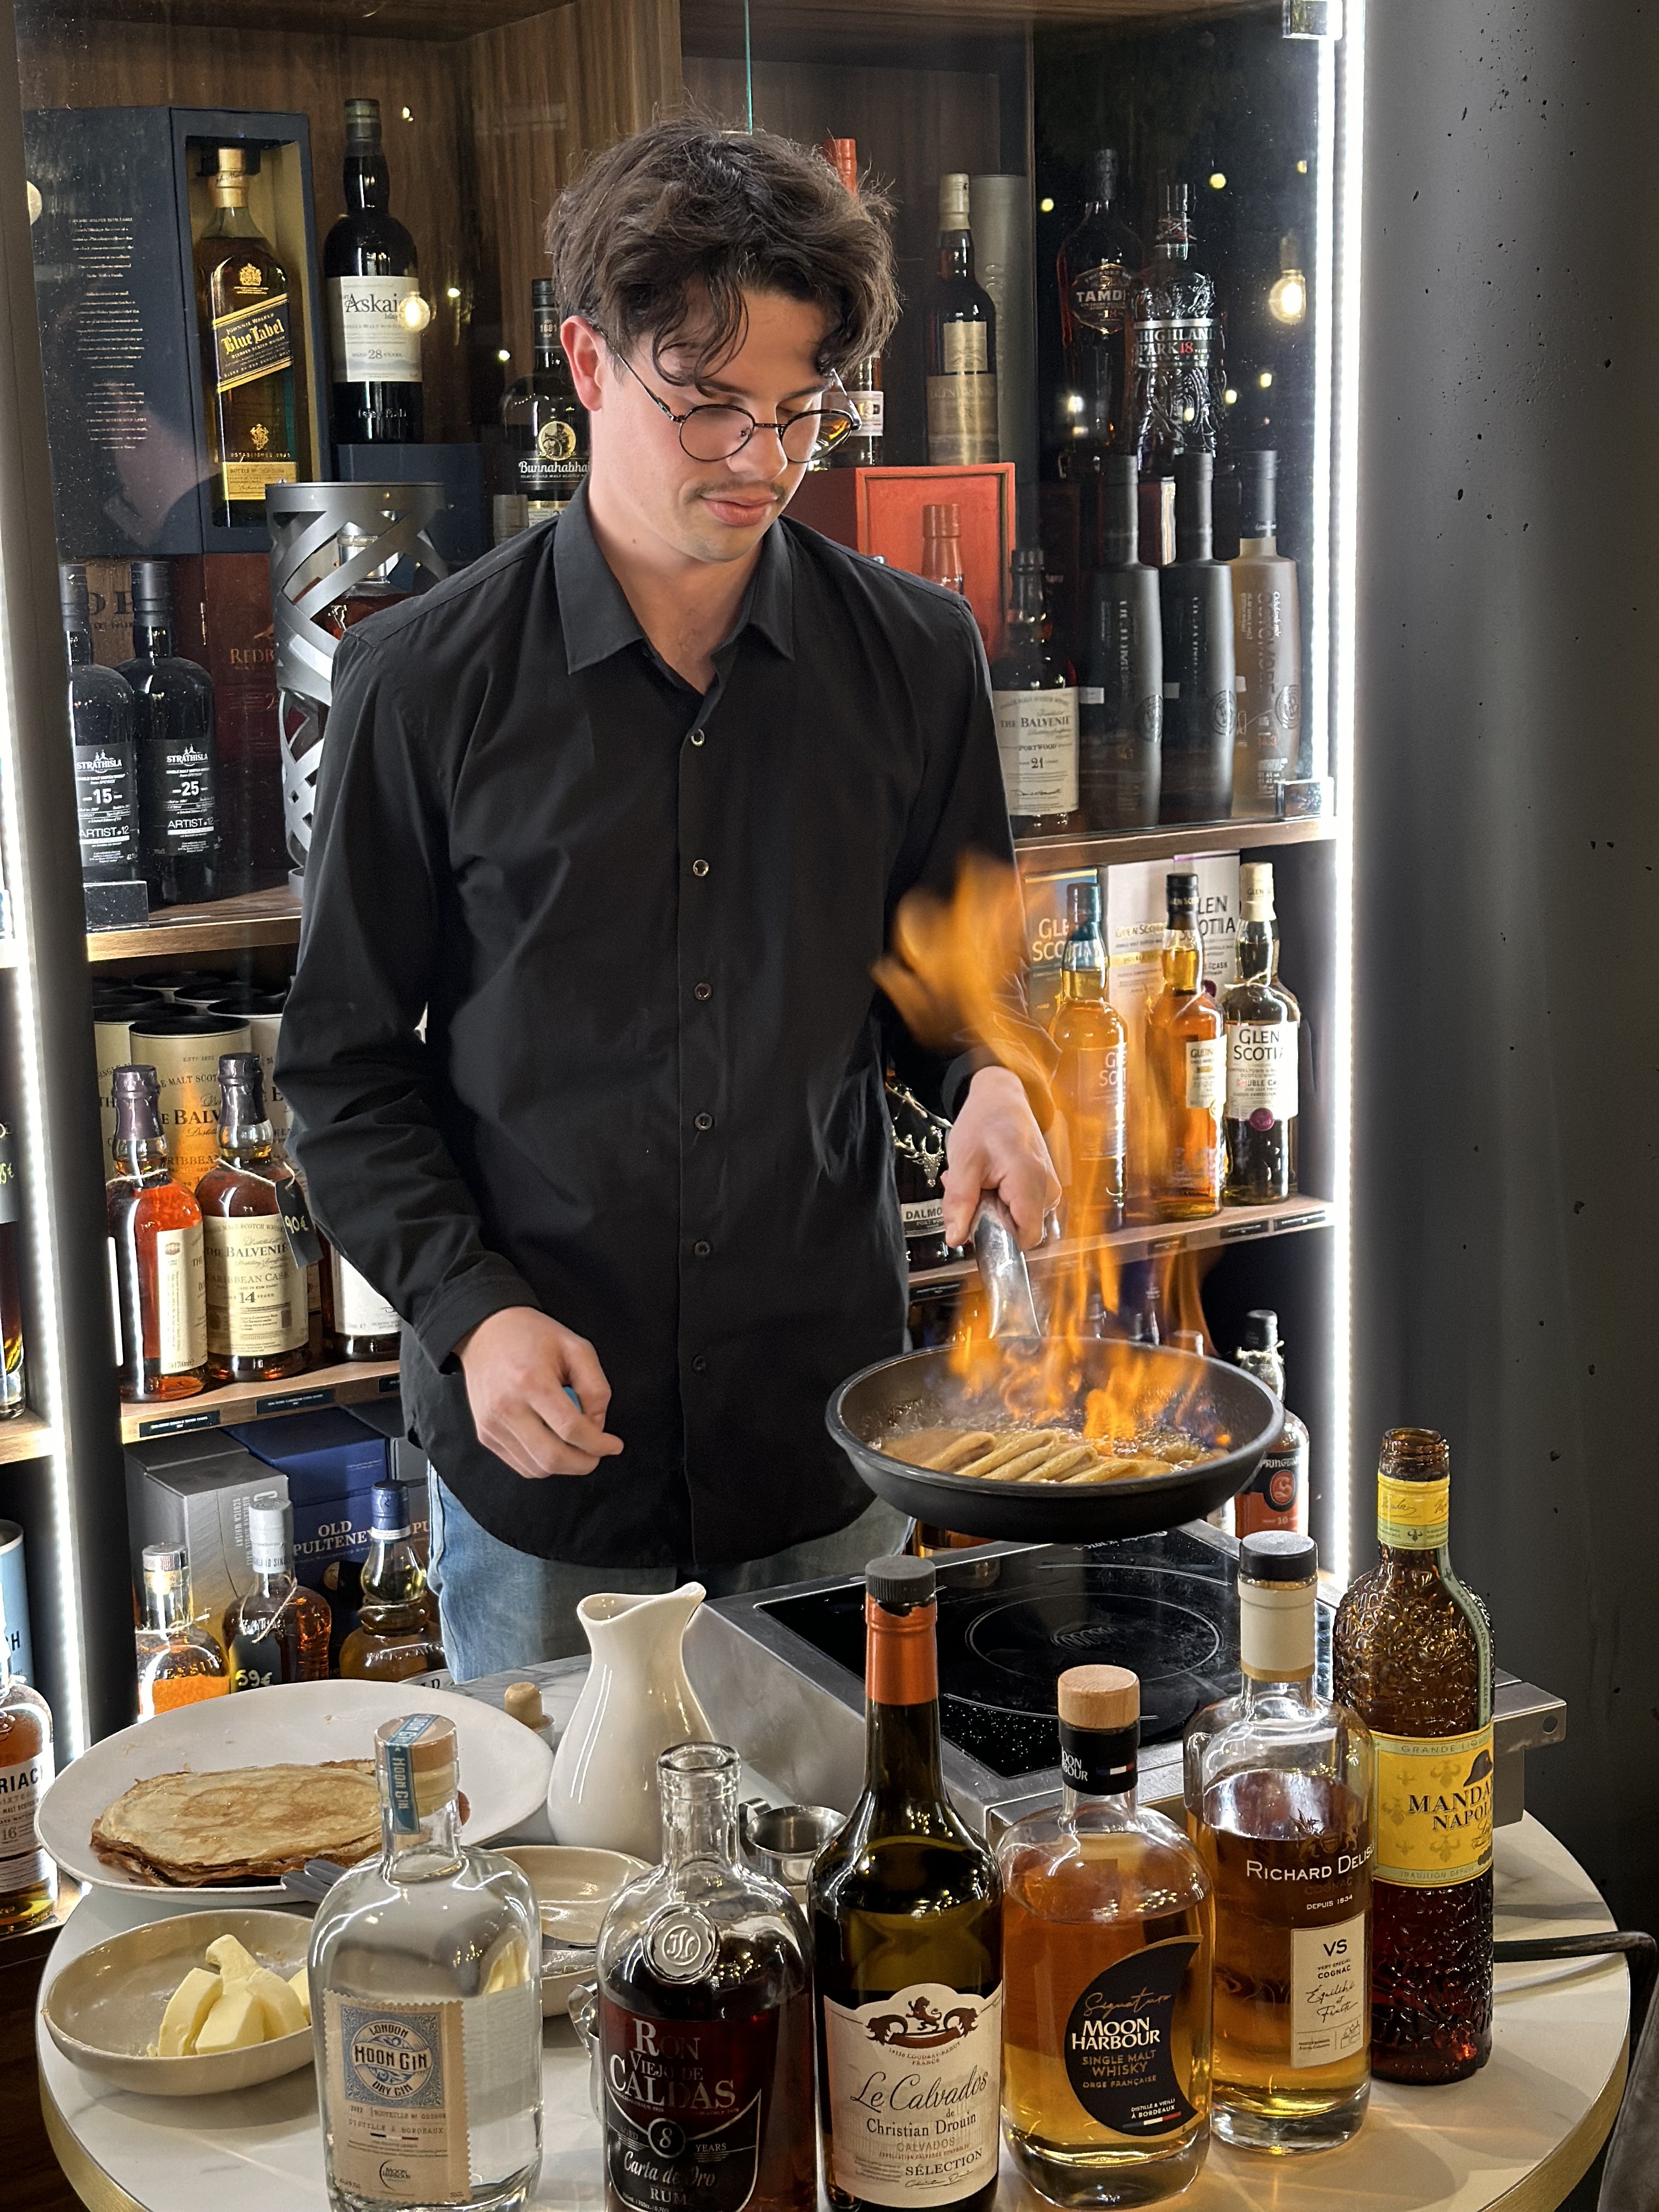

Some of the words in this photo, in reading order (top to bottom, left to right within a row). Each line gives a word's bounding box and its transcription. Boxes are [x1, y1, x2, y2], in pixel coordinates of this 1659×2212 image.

[345, 293, 399, 313] Askai
[1076, 290, 1126, 303] TAMD
[221, 332, 253, 355] Blue
[250, 318, 285, 344] Label
[368, 349, 382, 359] 28
[1139, 341, 1179, 357] PARK
[1180, 341, 1194, 354] 18
[518, 461, 590, 473] Bunnahabhai
[230, 648, 275, 664] REDB
[1021, 715, 1070, 728] BALVENIE
[76, 759, 122, 770] STRATHISLA
[167, 753, 208, 764] STRATHISLA
[1031, 758, 1043, 769] 21
[93, 788, 112, 804] 15
[182, 781, 199, 796] 25
[1247, 887, 1264, 895] GLEN
[1198, 895, 1228, 915] LEN
[1039, 918, 1069, 940] GLE
[1198, 917, 1237, 936] OTIA
[1239, 1029, 1280, 1045] GLEN
[169, 1076, 193, 1086] MALT
[195, 1074, 218, 1083] SCOT
[173, 1108, 219, 1125] BALV
[906, 1207, 943, 1220] DALMO
[227, 1243, 288, 1258] BALVENIE
[239, 1291, 257, 1304] 14
[232, 1498, 241, 1522] SCOTCH
[234, 1522, 244, 1547] WHISKY
[318, 1521, 352, 1537] OLD
[1401, 1744, 1456, 1754] GRANDE
[1061, 1746, 1082, 1770] OON
[0, 1765, 43, 1795] RIAC
[395, 1790, 410, 1809] GIN
[1408, 1778, 1493, 1814] MANDA
[1432, 1800, 1491, 1831] NAPOL
[2, 1826, 17, 1840] 16
[1246, 1859, 1333, 1881] RICHARD
[1338, 1842, 1375, 1875] DELISL
[1306, 1900, 1334, 1910] DEPUIS
[1336, 1894, 1353, 1905] 1834
[1323, 1938, 1347, 1957] VS
[1317, 1964, 1351, 1979] COGNAC
[369, 2025, 409, 2039] LONDON
[1082, 2017, 1150, 2037] MOON
[632, 2017, 701, 2061] RON
[1071, 2029, 1161, 2050] HARBOUR
[354, 2045, 396, 2067] MOON
[399, 2052, 428, 2071] GIN
[628, 2050, 675, 2078] VIEJO
[682, 2067, 704, 2081] DE
[1081, 2055, 1124, 2066] SINGLE
[1127, 2049, 1156, 2063] MALT
[1092, 2061, 1148, 2077] WHISKY
[372, 2080, 391, 2096] DRY
[394, 2084, 413, 2097] GIN
[610, 2053, 737, 2109] CALDAS
[850, 2071, 887, 2113] Le
[889, 2064, 989, 2111] Calvados
[1110, 2074, 1157, 2089] FRANÇAISE
[946, 2107, 955, 2118] de
[1138, 2105, 1176, 2118] BORDEAUX
[867, 2117, 929, 2137] Christian
[935, 2111, 977, 2135] Drouin
[620, 2125, 639, 2141] AGED
[659, 2127, 673, 2149] 8
[695, 2142, 727, 2152] YEARS
[897, 2137, 955, 2152] CALVADOS
[623, 2151, 659, 2182] Carta
[663, 2166, 680, 2184] de
[905, 2147, 983, 2176] SÉLECTION
[650, 2187, 689, 2205] RUM
